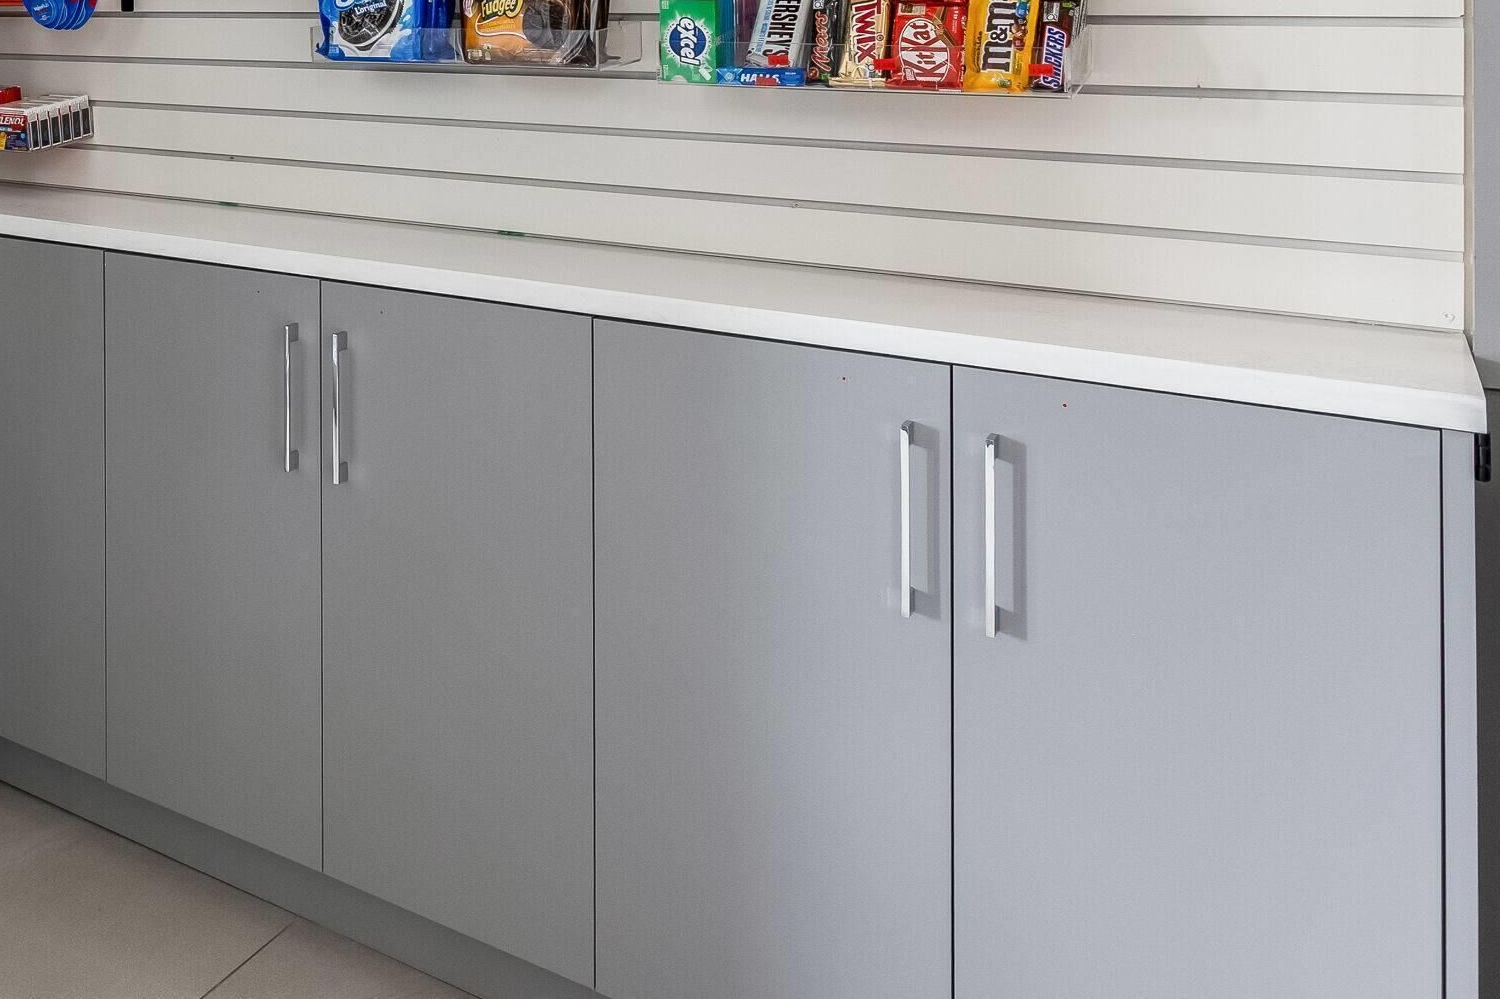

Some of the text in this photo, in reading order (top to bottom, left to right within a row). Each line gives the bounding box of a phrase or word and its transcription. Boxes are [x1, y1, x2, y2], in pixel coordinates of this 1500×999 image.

[355, 1, 387, 14] L'original
[677, 16, 702, 66] excel
[901, 20, 948, 82] KitKat
